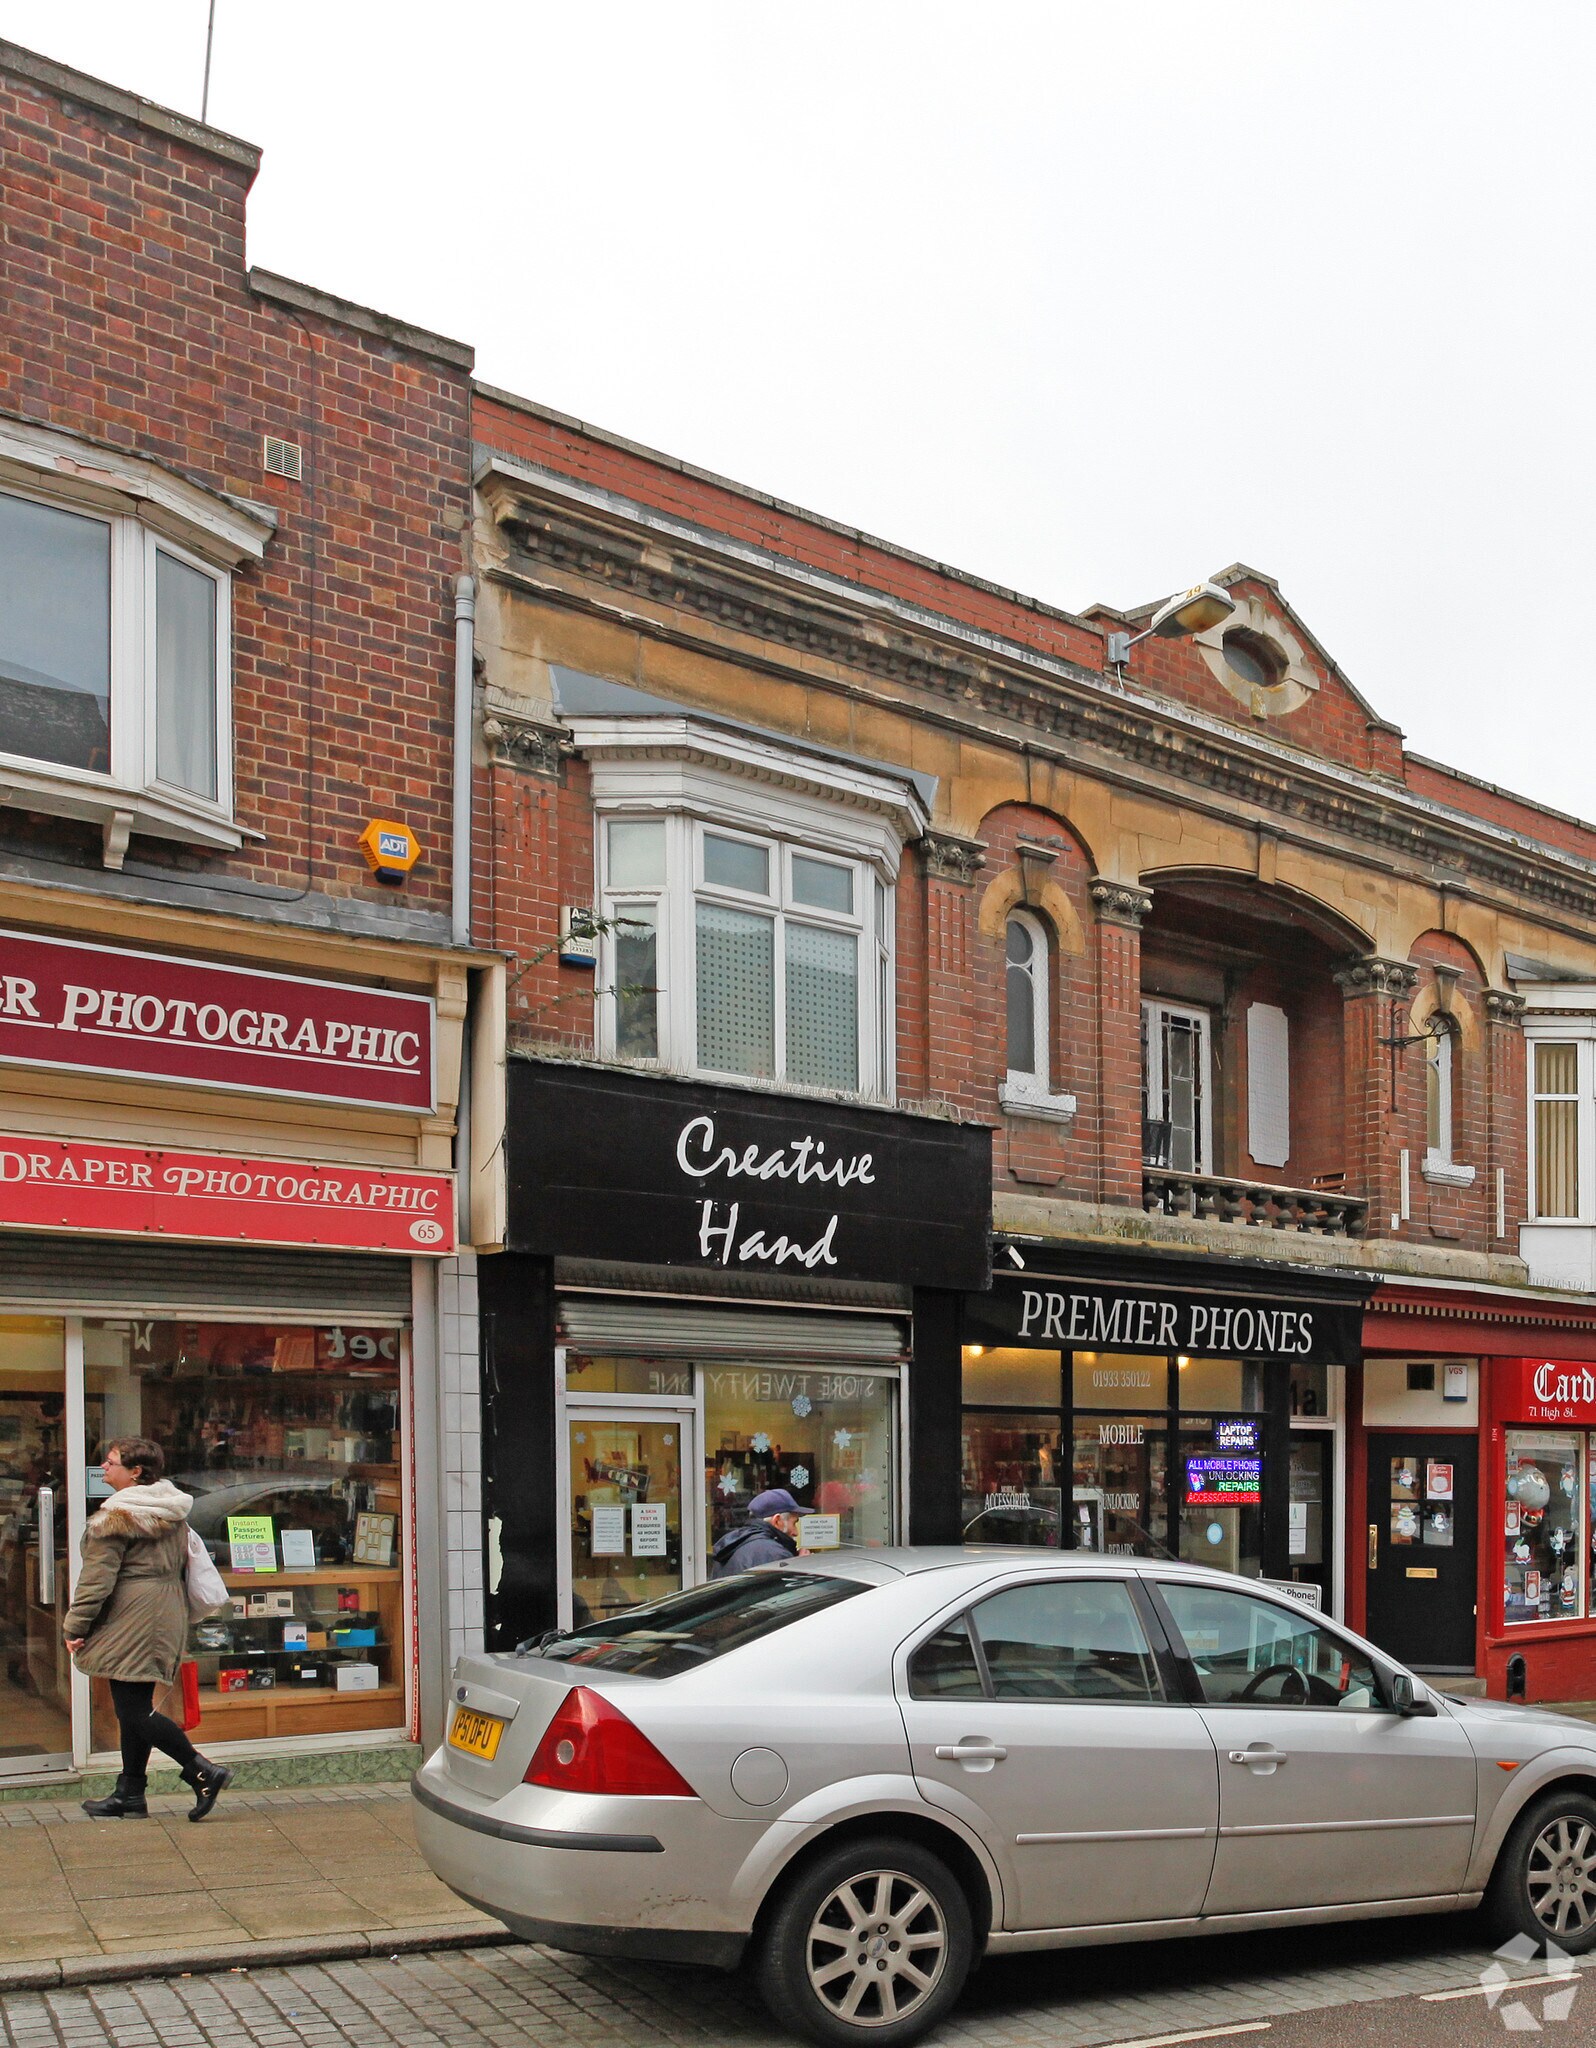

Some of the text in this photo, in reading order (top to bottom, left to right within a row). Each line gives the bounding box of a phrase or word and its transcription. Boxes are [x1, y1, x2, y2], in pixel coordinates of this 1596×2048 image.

[380, 838, 407, 854] ADT
[0, 975, 421, 1067] R PHOTOGRAPHIC
[676, 1115, 876, 1187] Creative
[0, 1151, 439, 1211] DRAPER PHOTOGRAPHIC
[417, 1223, 436, 1240] 65
[699, 1199, 838, 1268] Hand
[1018, 1290, 1313, 1355] PREMIER PHONES
[1092, 1370, 1151, 1388] 01933 350122
[1448, 1367, 1463, 1375] VGS
[1533, 1362, 1596, 1404] Card
[1528, 1406, 1537, 1417] 71
[1541, 1407, 1560, 1420] High
[1098, 1424, 1145, 1445] MOBILE
[1220, 1426, 1252, 1436] LAPTOP
[1220, 1436, 1254, 1446] REPAIRS
[1188, 1460, 1260, 1471] ALL MOBILE PHONE
[1208, 1471, 1260, 1481] UNLOCKING
[1218, 1481, 1260, 1492] REPAIRS
[985, 1492, 1031, 1510] ACCESSORIES
[1101, 1493, 1140, 1510] UNLOCKING
[233, 1526, 266, 1534] Passport
[1286, 1588, 1316, 1601] Phones
